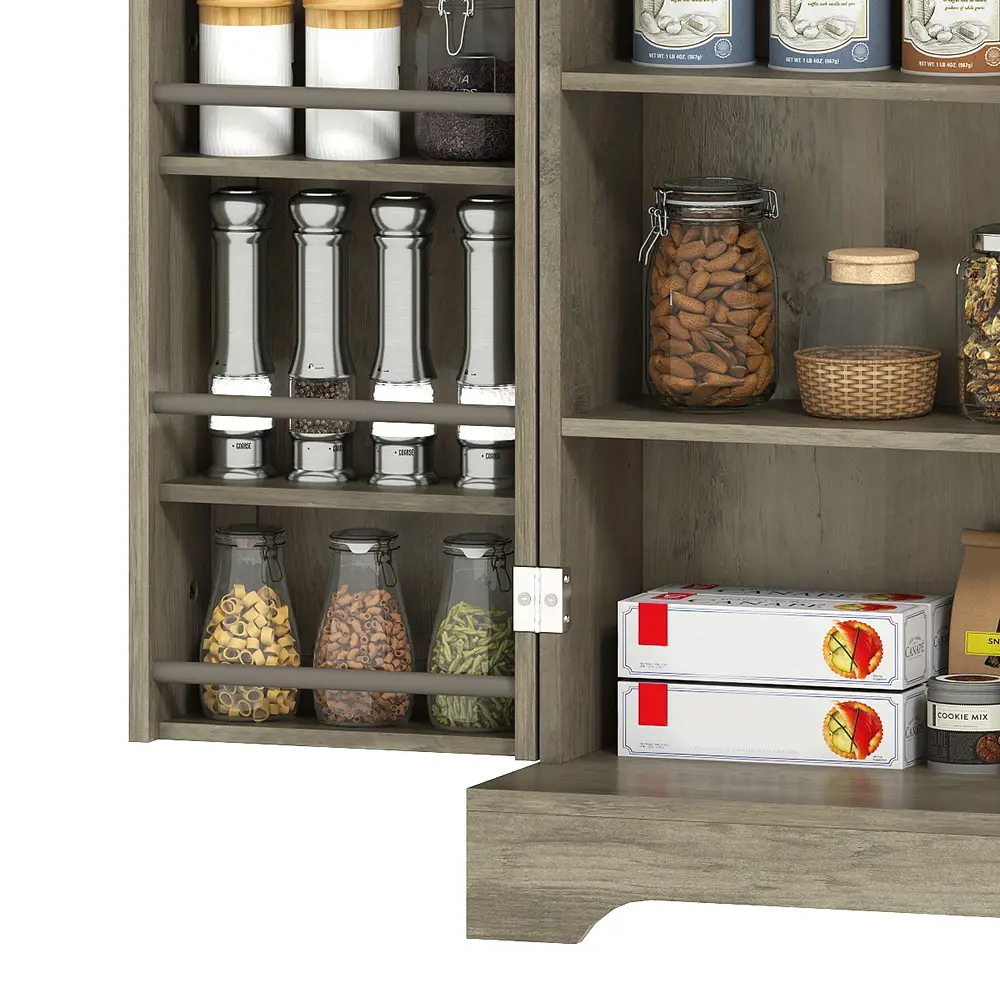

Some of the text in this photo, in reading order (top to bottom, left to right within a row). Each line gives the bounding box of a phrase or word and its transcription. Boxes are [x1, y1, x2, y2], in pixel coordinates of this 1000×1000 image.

[236, 442, 252, 450] COARSE
[937, 712, 988, 721] COOKIE MIX
